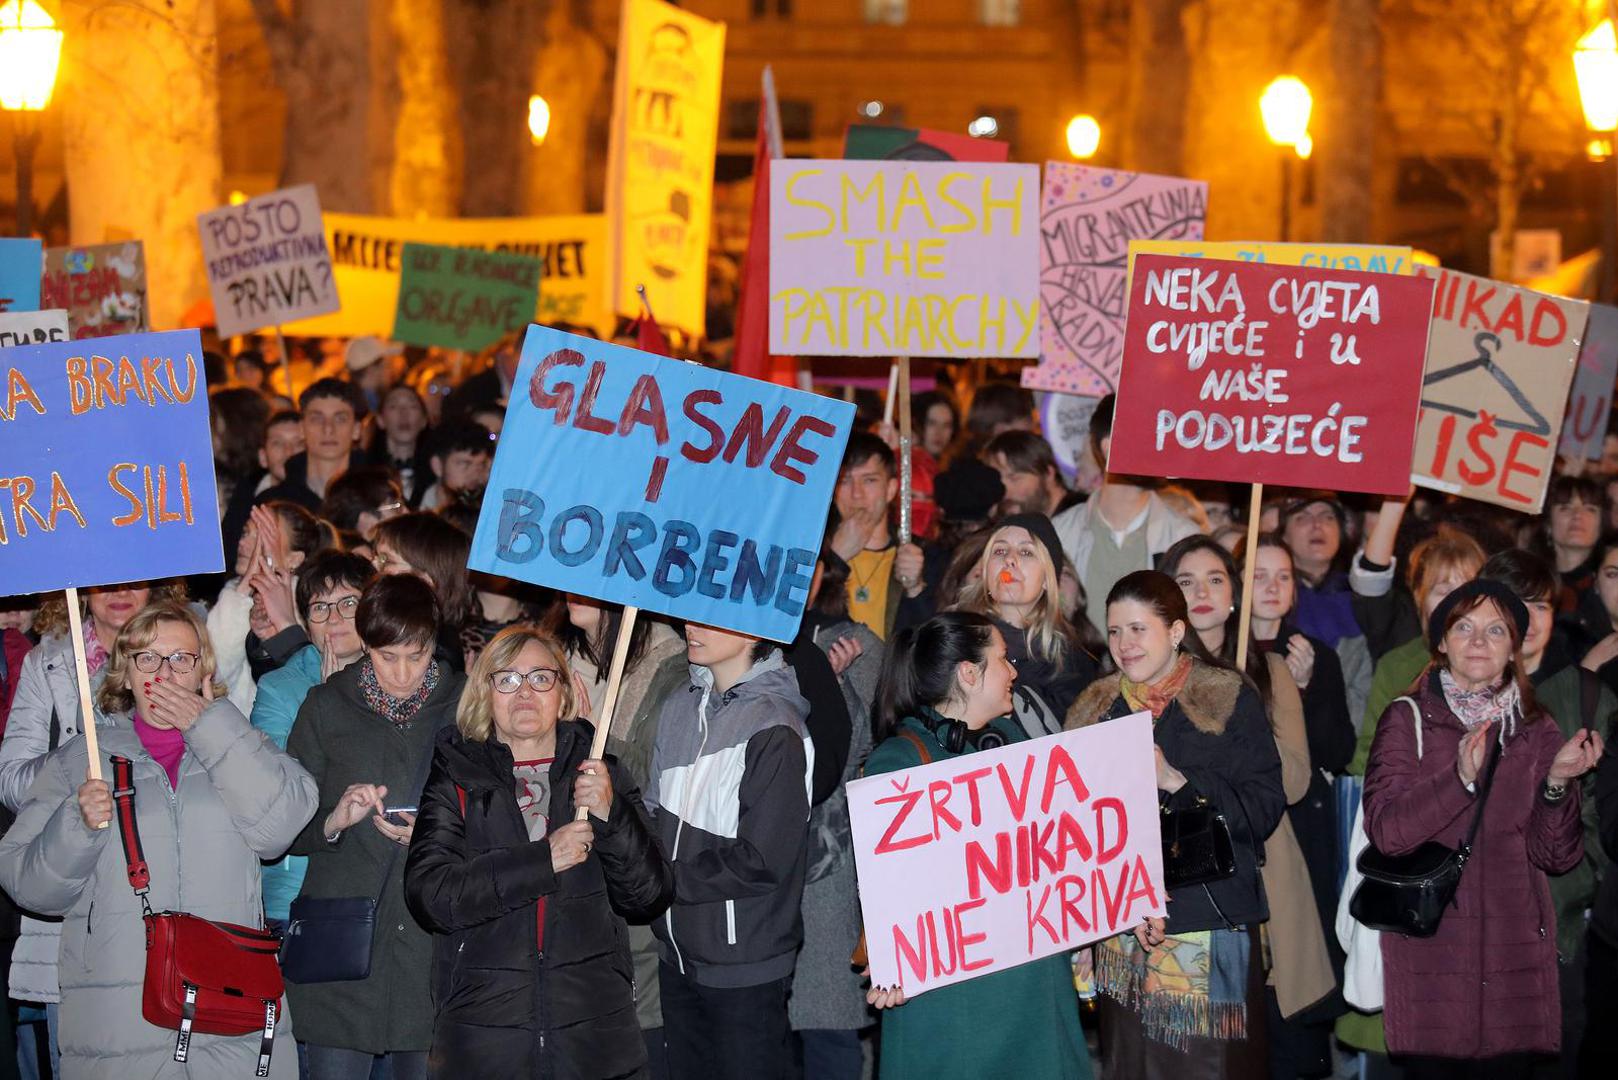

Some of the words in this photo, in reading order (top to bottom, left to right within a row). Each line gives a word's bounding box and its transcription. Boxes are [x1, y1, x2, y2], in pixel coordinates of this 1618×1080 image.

[784, 169, 1023, 240] SMASH
[227, 260, 332, 319] PRAVA?
[844, 238, 947, 279] THE
[772, 286, 1038, 354] PATRIARCHY
[1144, 268, 1246, 313] NEKA
[1268, 277, 1381, 329] CVJETA
[1051, 294, 1122, 376] RADN
[0, 367, 47, 421] A
[66, 353, 198, 415] BRAKU
[528, 348, 837, 485] GLASNE
[1199, 362, 1289, 403] NAŠE
[645, 455, 669, 503] I
[1419, 408, 1549, 504] IŠE
[108, 460, 195, 530] SILI
[495, 488, 818, 617] BORBENE
[874, 744, 1090, 855] ŽRTVA
[965, 797, 1128, 900] NIKAD
[892, 897, 994, 990] NIJE
[1026, 854, 1159, 955] KRIVA
